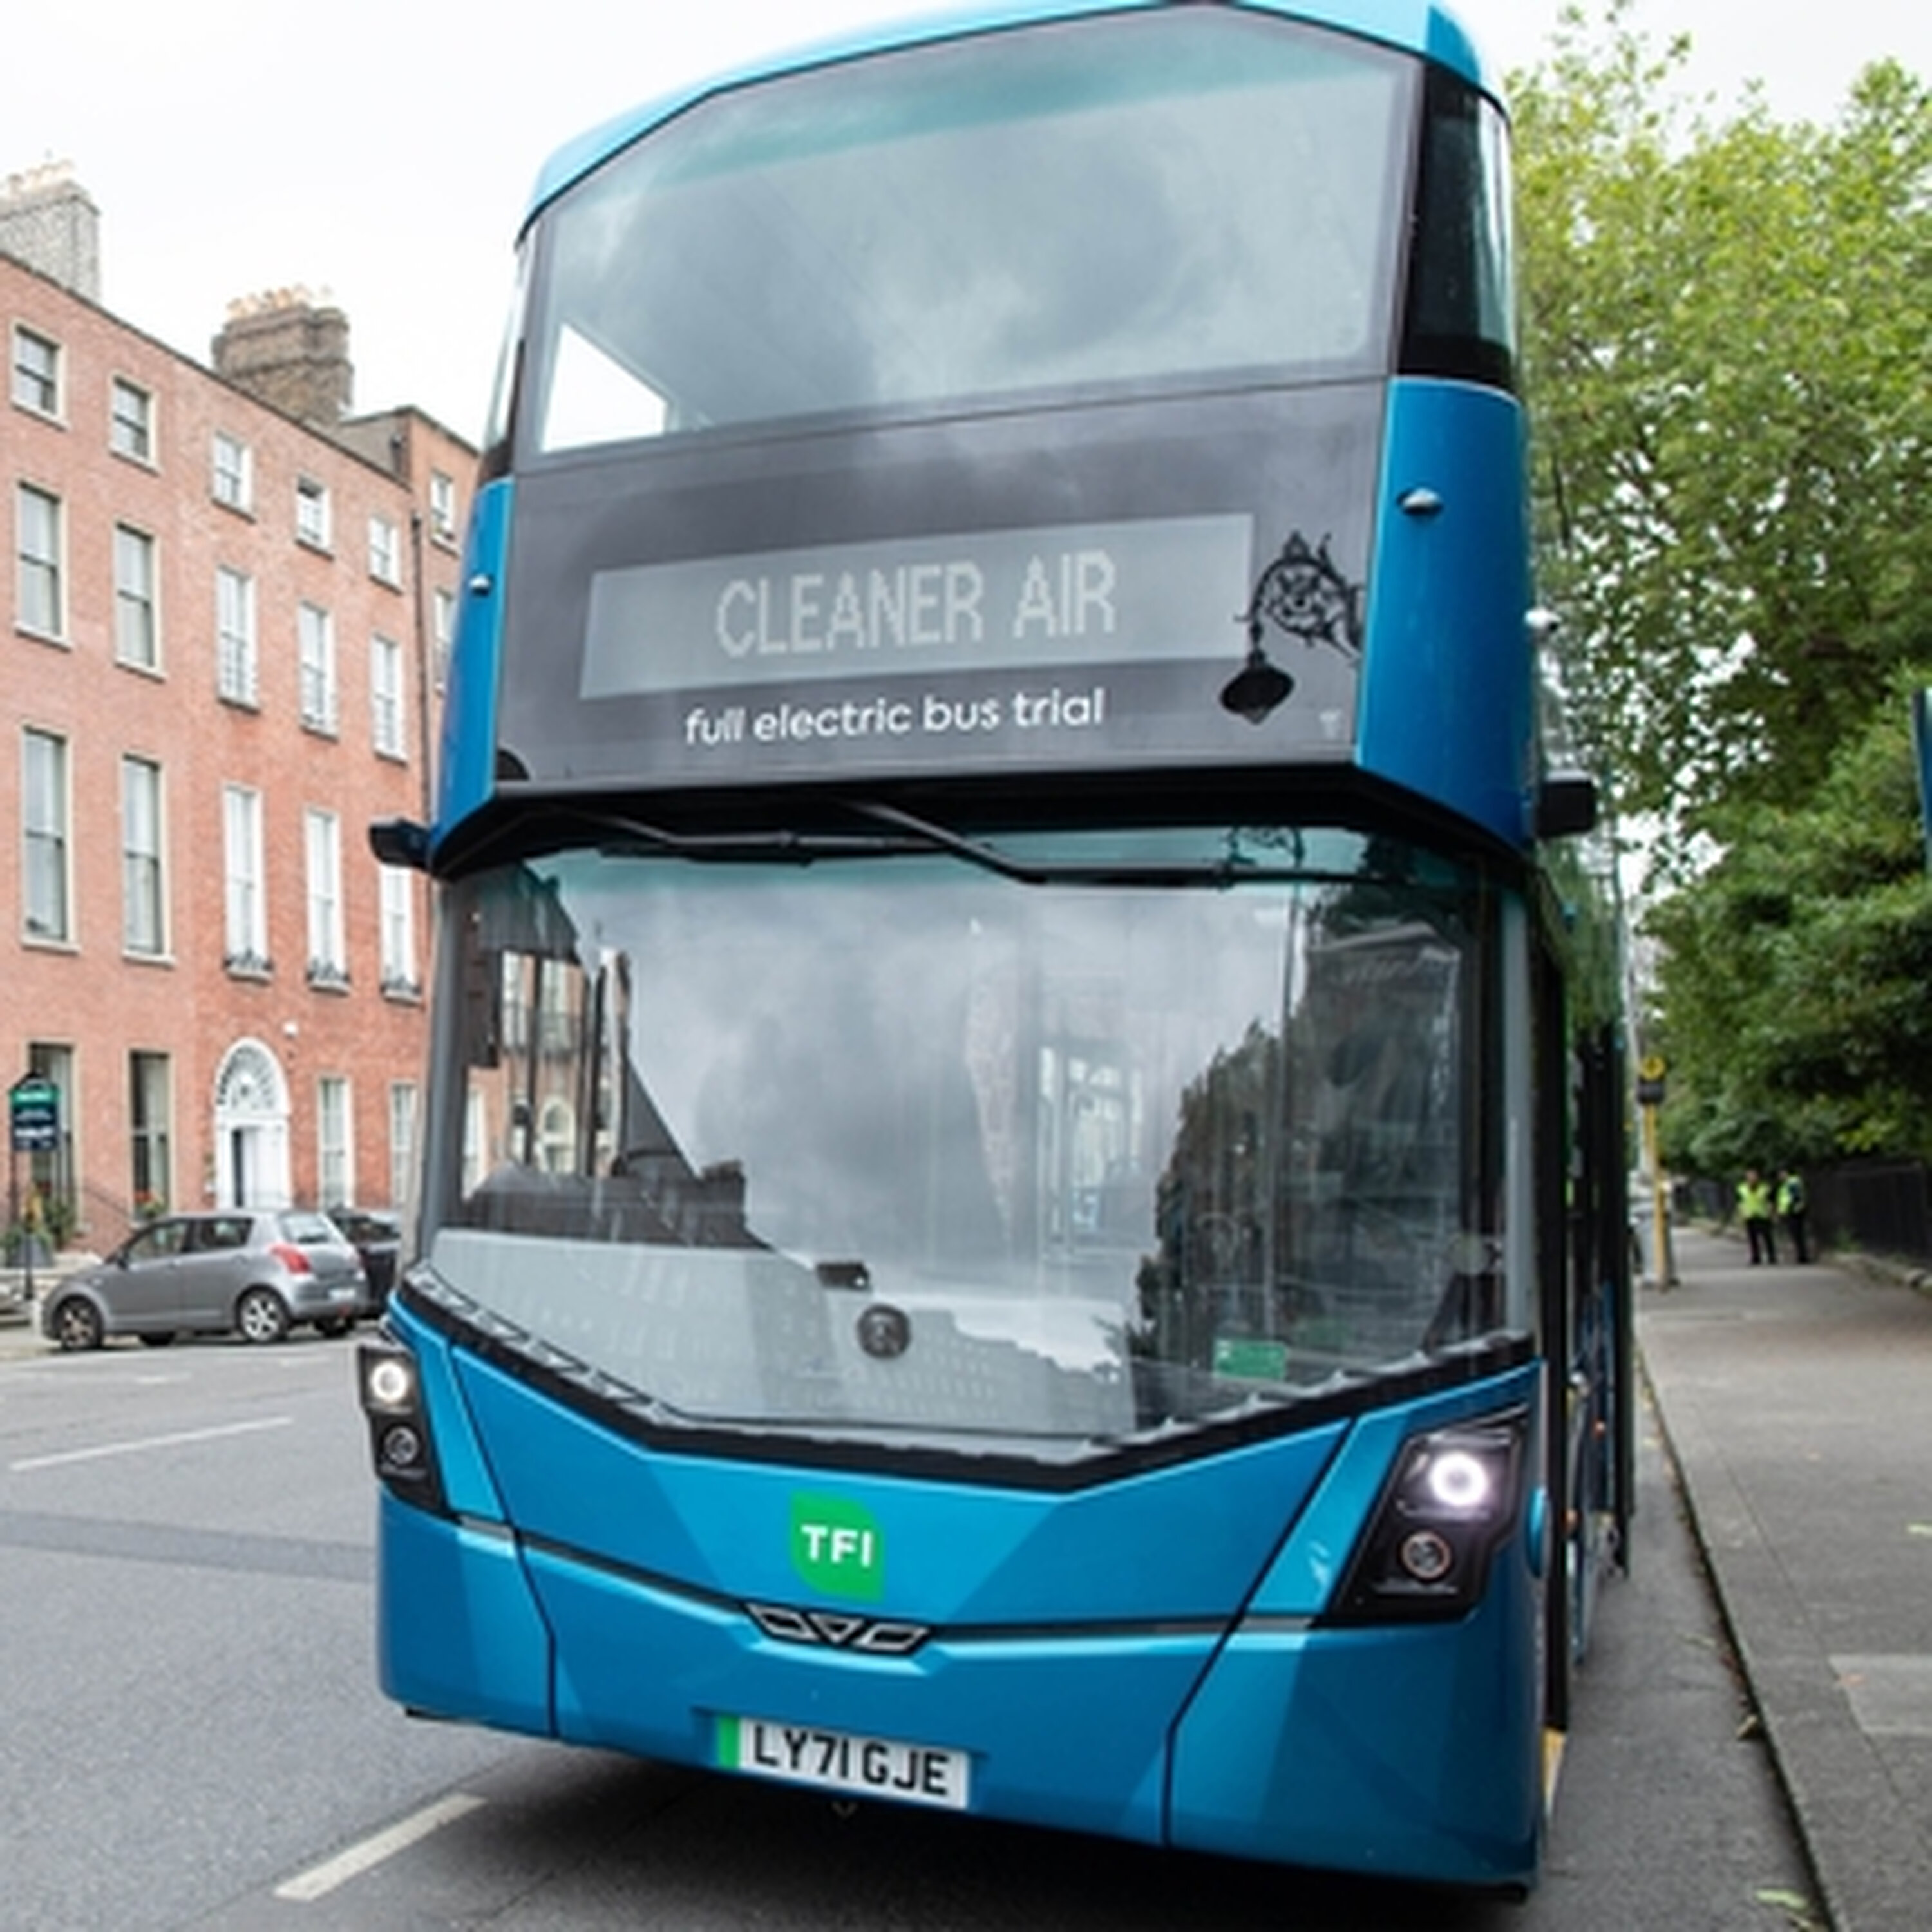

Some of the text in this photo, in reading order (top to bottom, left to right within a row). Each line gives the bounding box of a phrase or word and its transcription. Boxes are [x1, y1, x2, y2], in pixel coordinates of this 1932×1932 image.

[715, 549, 1116, 658] CLEANER AIR
[685, 687, 1104, 744] full electric bus trial
[800, 1524, 873, 1567] TFI
